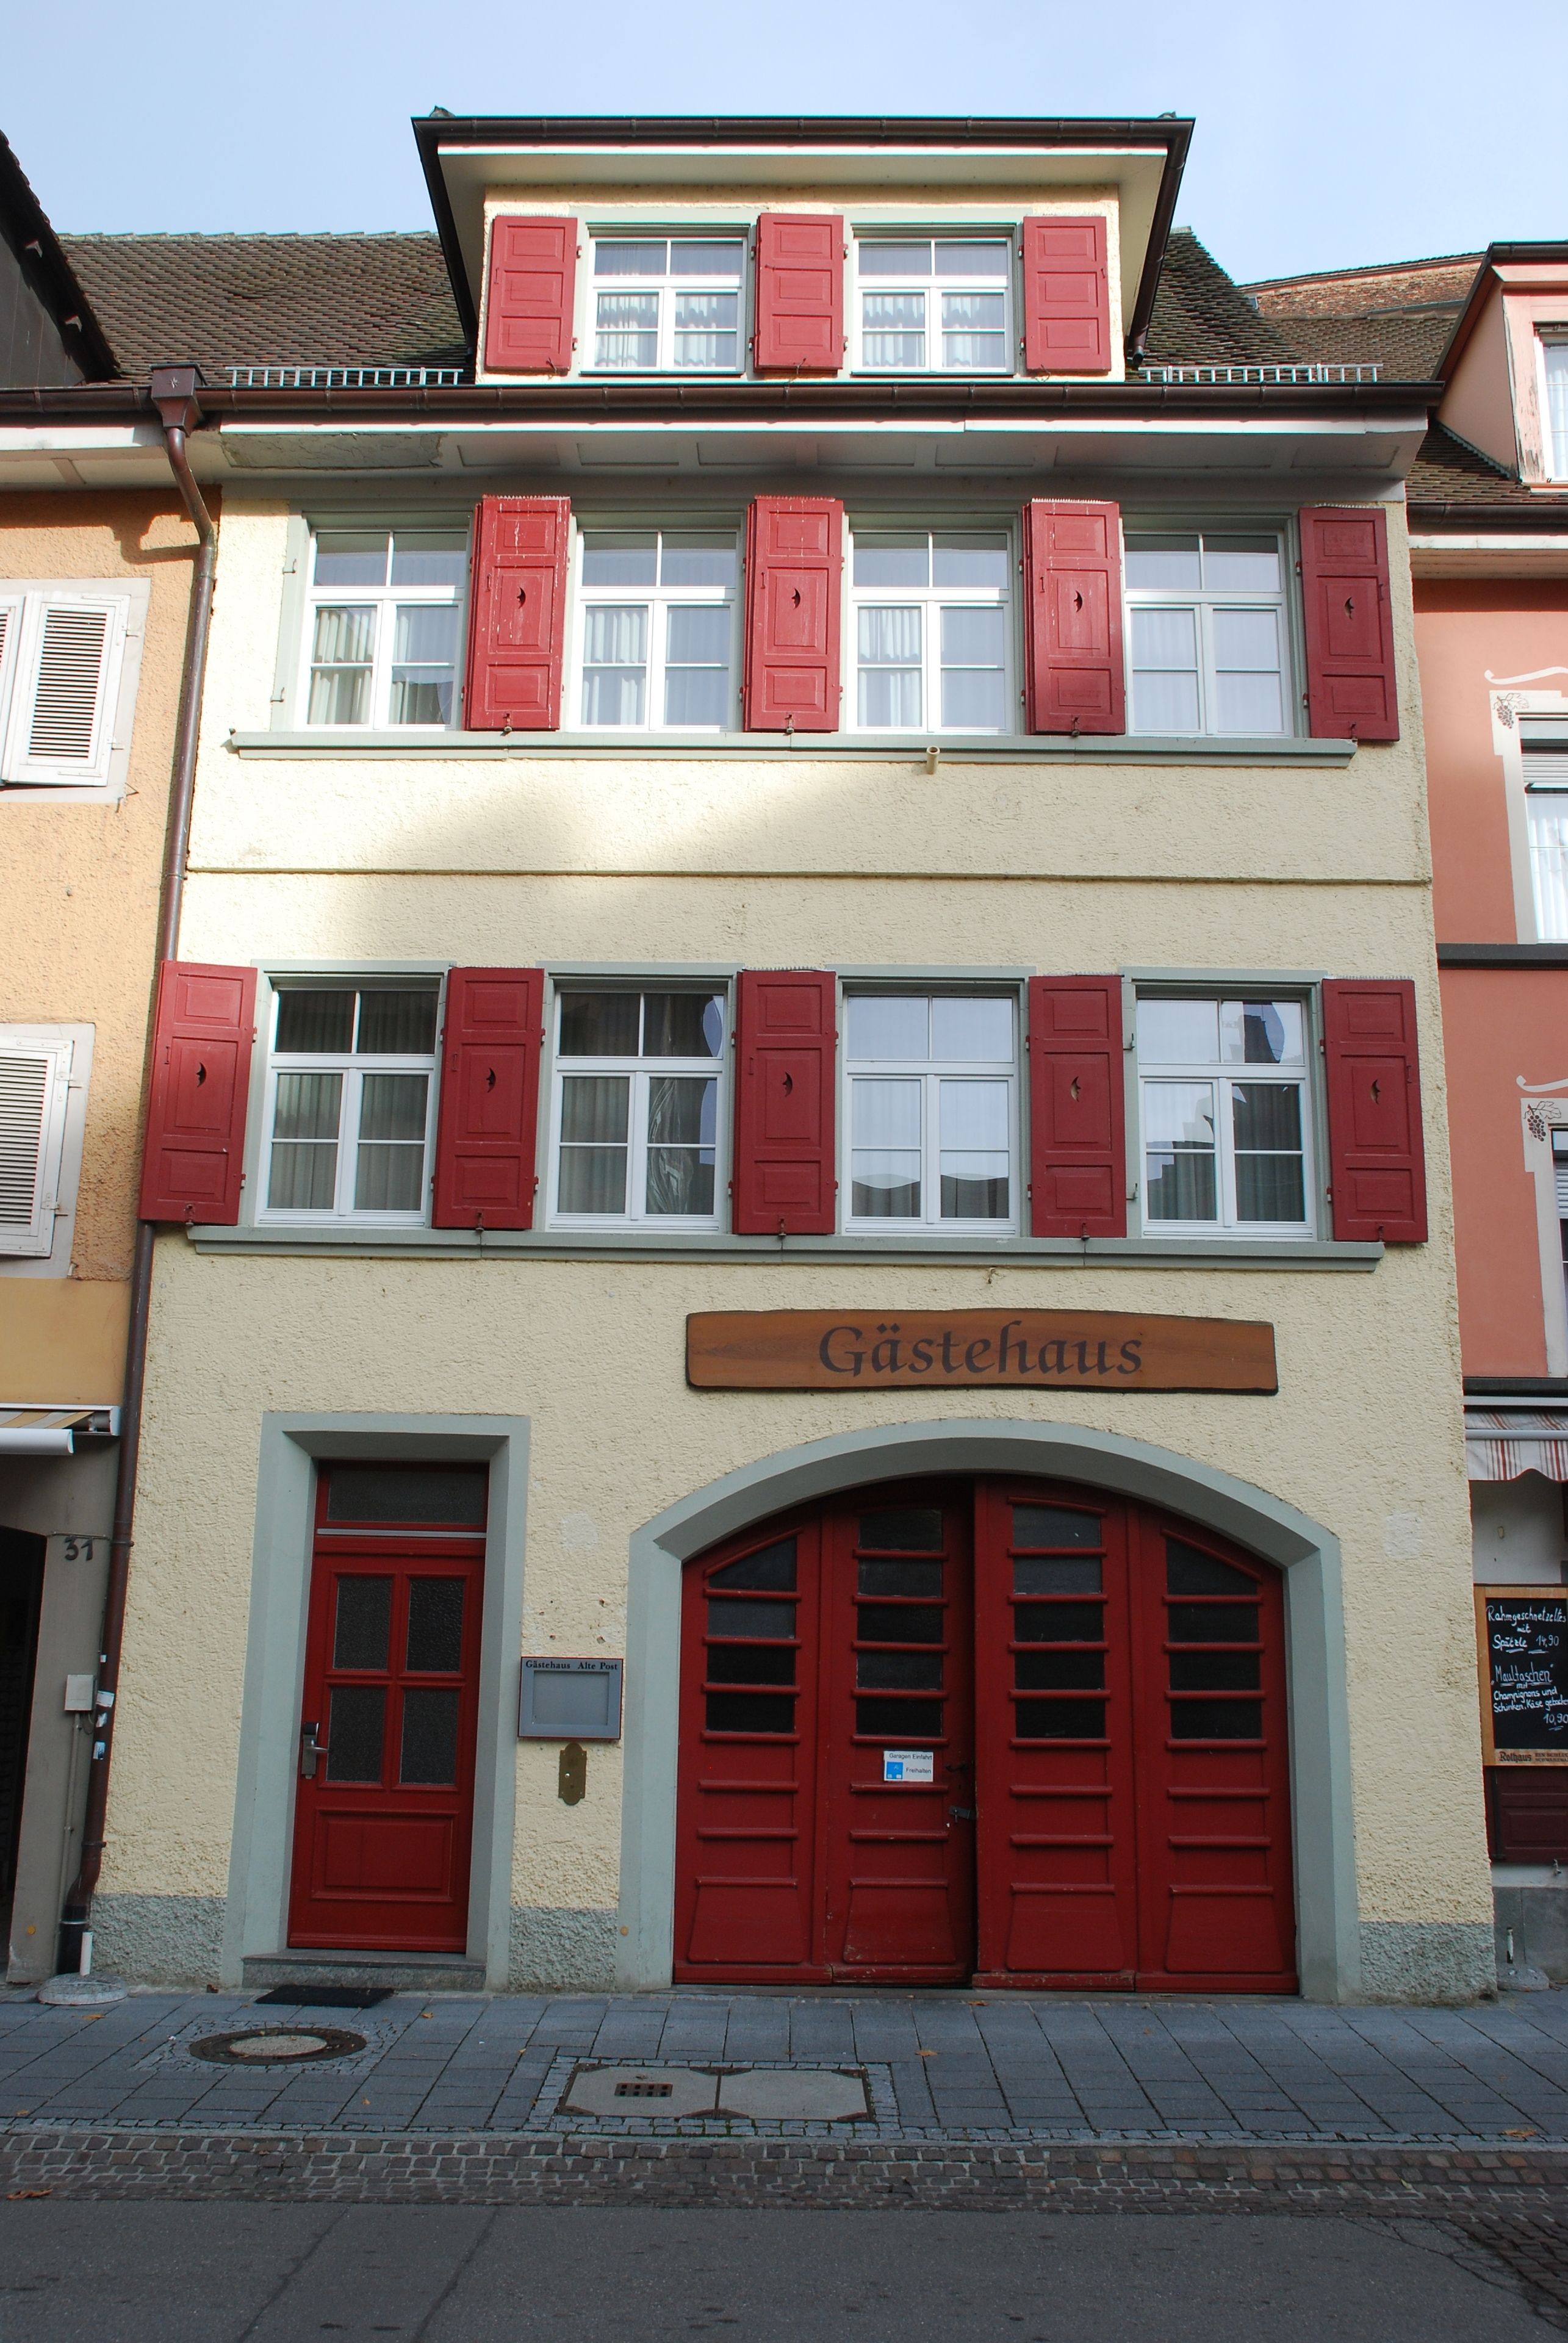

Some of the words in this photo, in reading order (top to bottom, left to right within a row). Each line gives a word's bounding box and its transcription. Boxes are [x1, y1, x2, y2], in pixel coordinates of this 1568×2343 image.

[819, 1320, 1142, 1377] Gästehaus
[65, 1536, 93, 1561] 31
[1486, 1605, 1567, 1627] Rahmgeschnetzeltes
[1517, 1623, 1531, 1633] mit
[1492, 1634, 1528, 1651] Spätzle
[1536, 1635, 1559, 1647] 14,90
[525, 1660, 571, 1669] Gästehaus
[1494, 1690, 1541, 1704] Champignons
[1542, 1685, 1558, 1696] und
[1526, 1699, 1544, 1709] Käse
[1499, 1751, 1532, 1763] Rothaus
